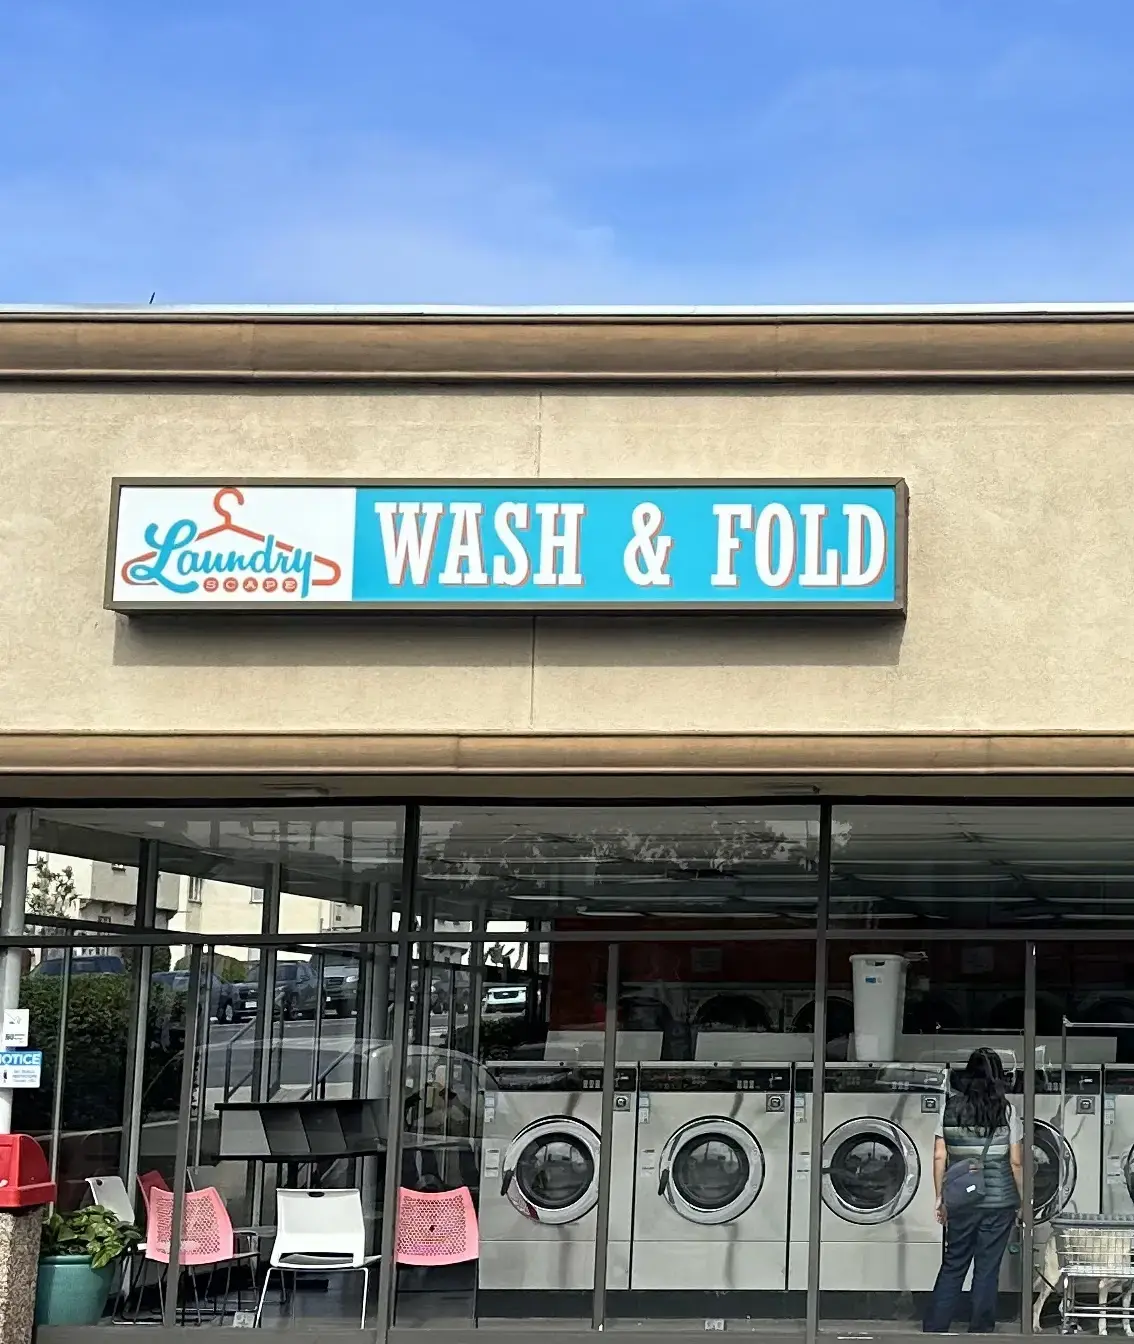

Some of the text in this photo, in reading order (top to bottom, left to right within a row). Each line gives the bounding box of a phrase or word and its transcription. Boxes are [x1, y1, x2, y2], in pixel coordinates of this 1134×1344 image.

[130, 519, 312, 598] Laundry
[374, 501, 888, 588] WASH & FOLD
[203, 577, 298, 593] SCAPE
[0, 1053, 41, 1065] OTICE
